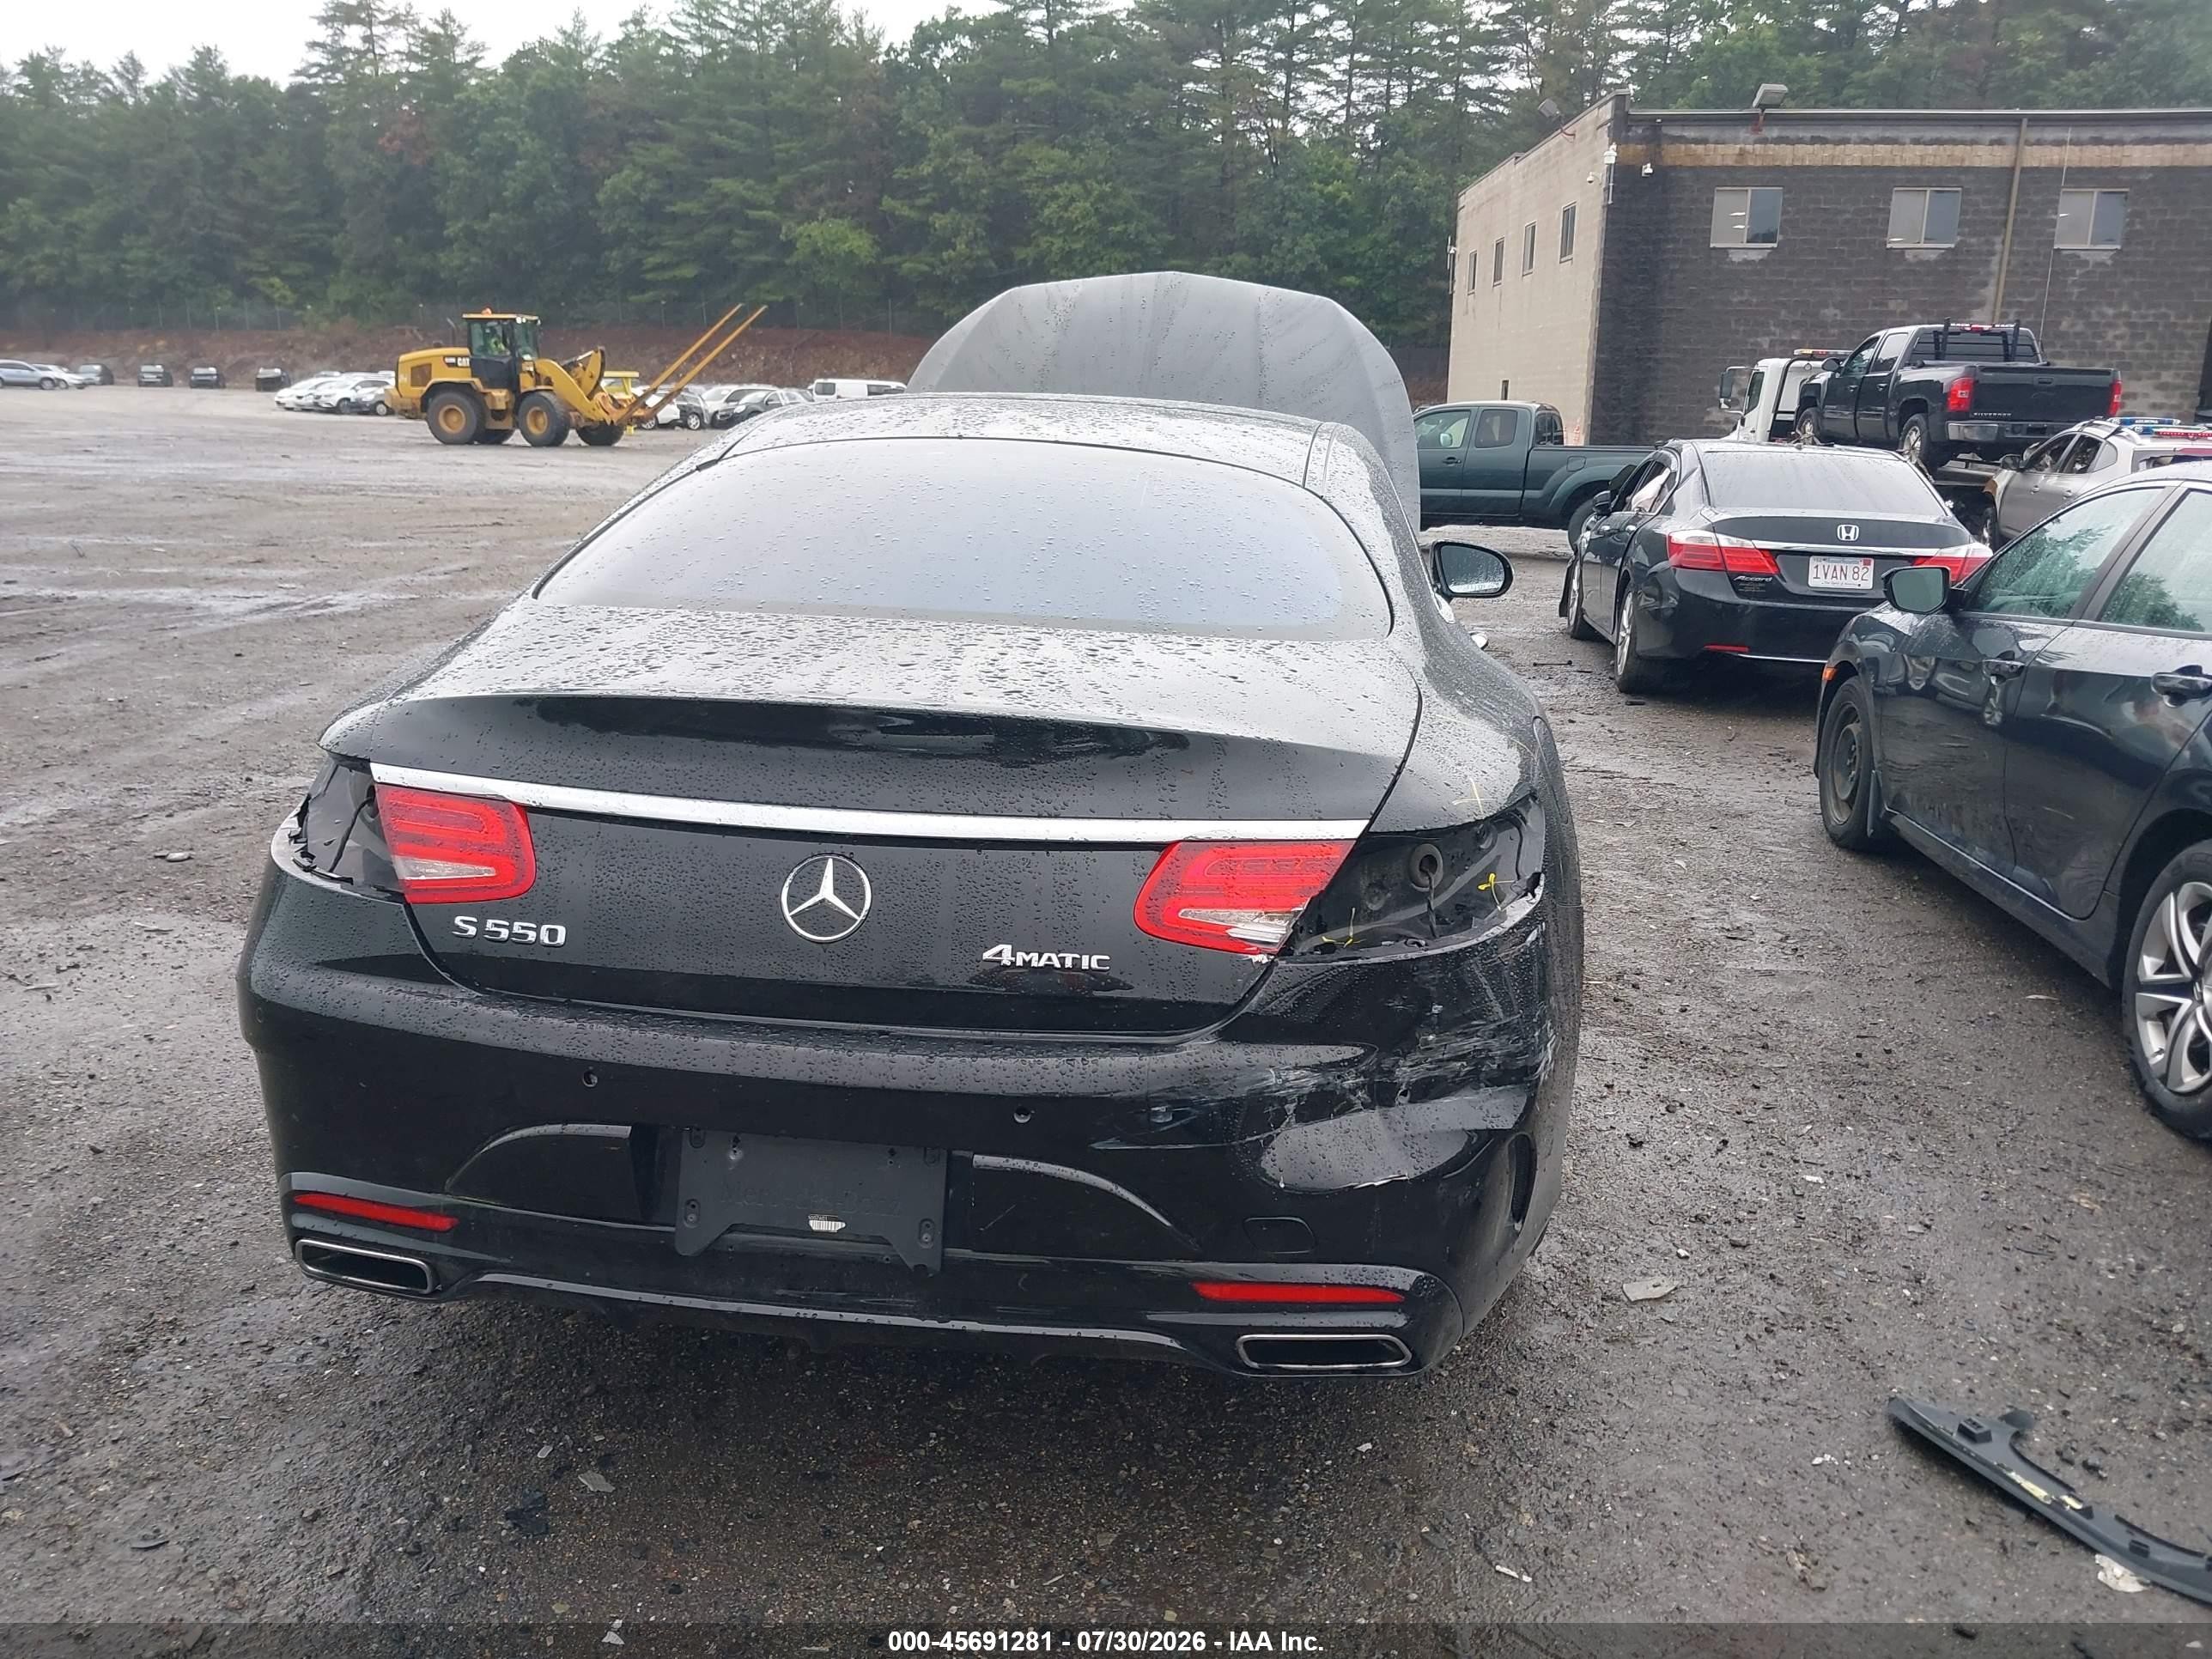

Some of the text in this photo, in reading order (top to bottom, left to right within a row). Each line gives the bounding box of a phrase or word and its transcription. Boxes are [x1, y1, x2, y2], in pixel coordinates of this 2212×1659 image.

[457, 356, 471, 368] CAT
[1813, 564, 1869, 581] 1VAN 82
[981, 944, 1110, 972] 4MATIC
